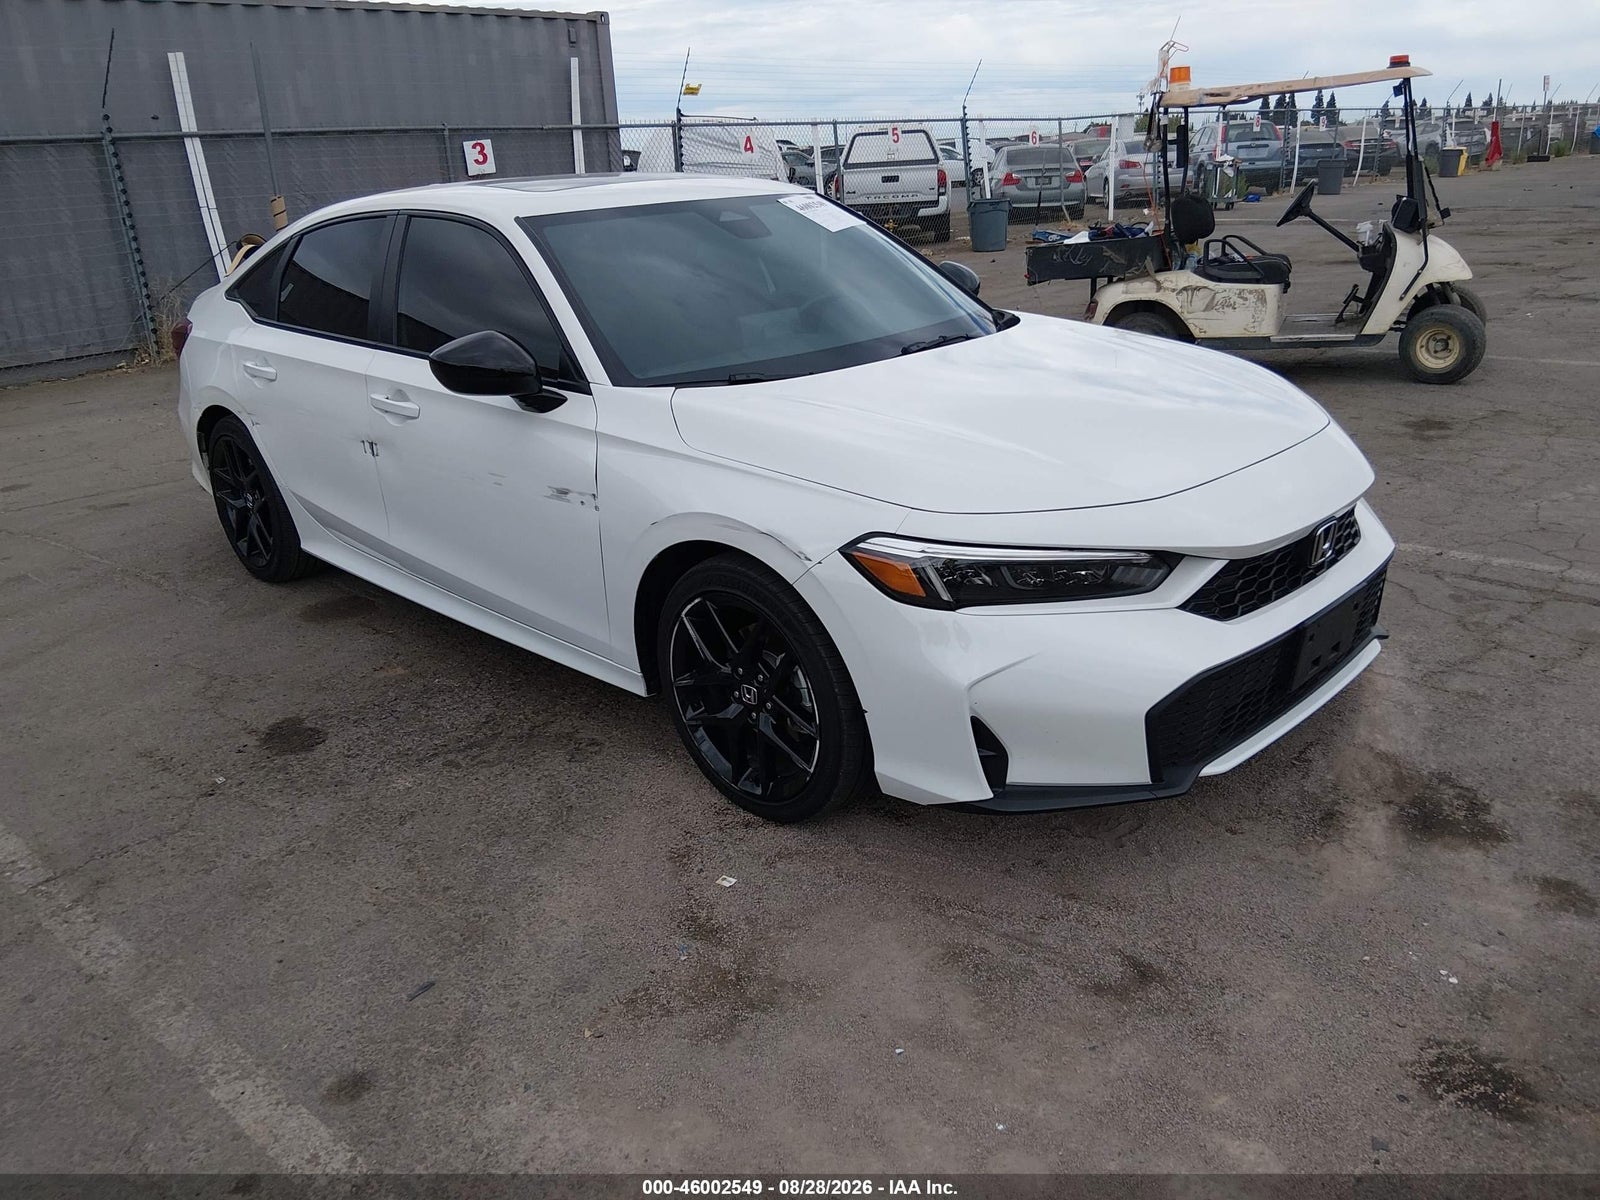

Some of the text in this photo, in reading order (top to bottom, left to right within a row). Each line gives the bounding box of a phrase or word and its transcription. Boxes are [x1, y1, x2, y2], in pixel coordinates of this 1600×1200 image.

[743, 135, 754, 154] 4
[891, 127, 900, 144] 5
[1031, 130, 1038, 145] 6
[471, 142, 488, 165] 3
